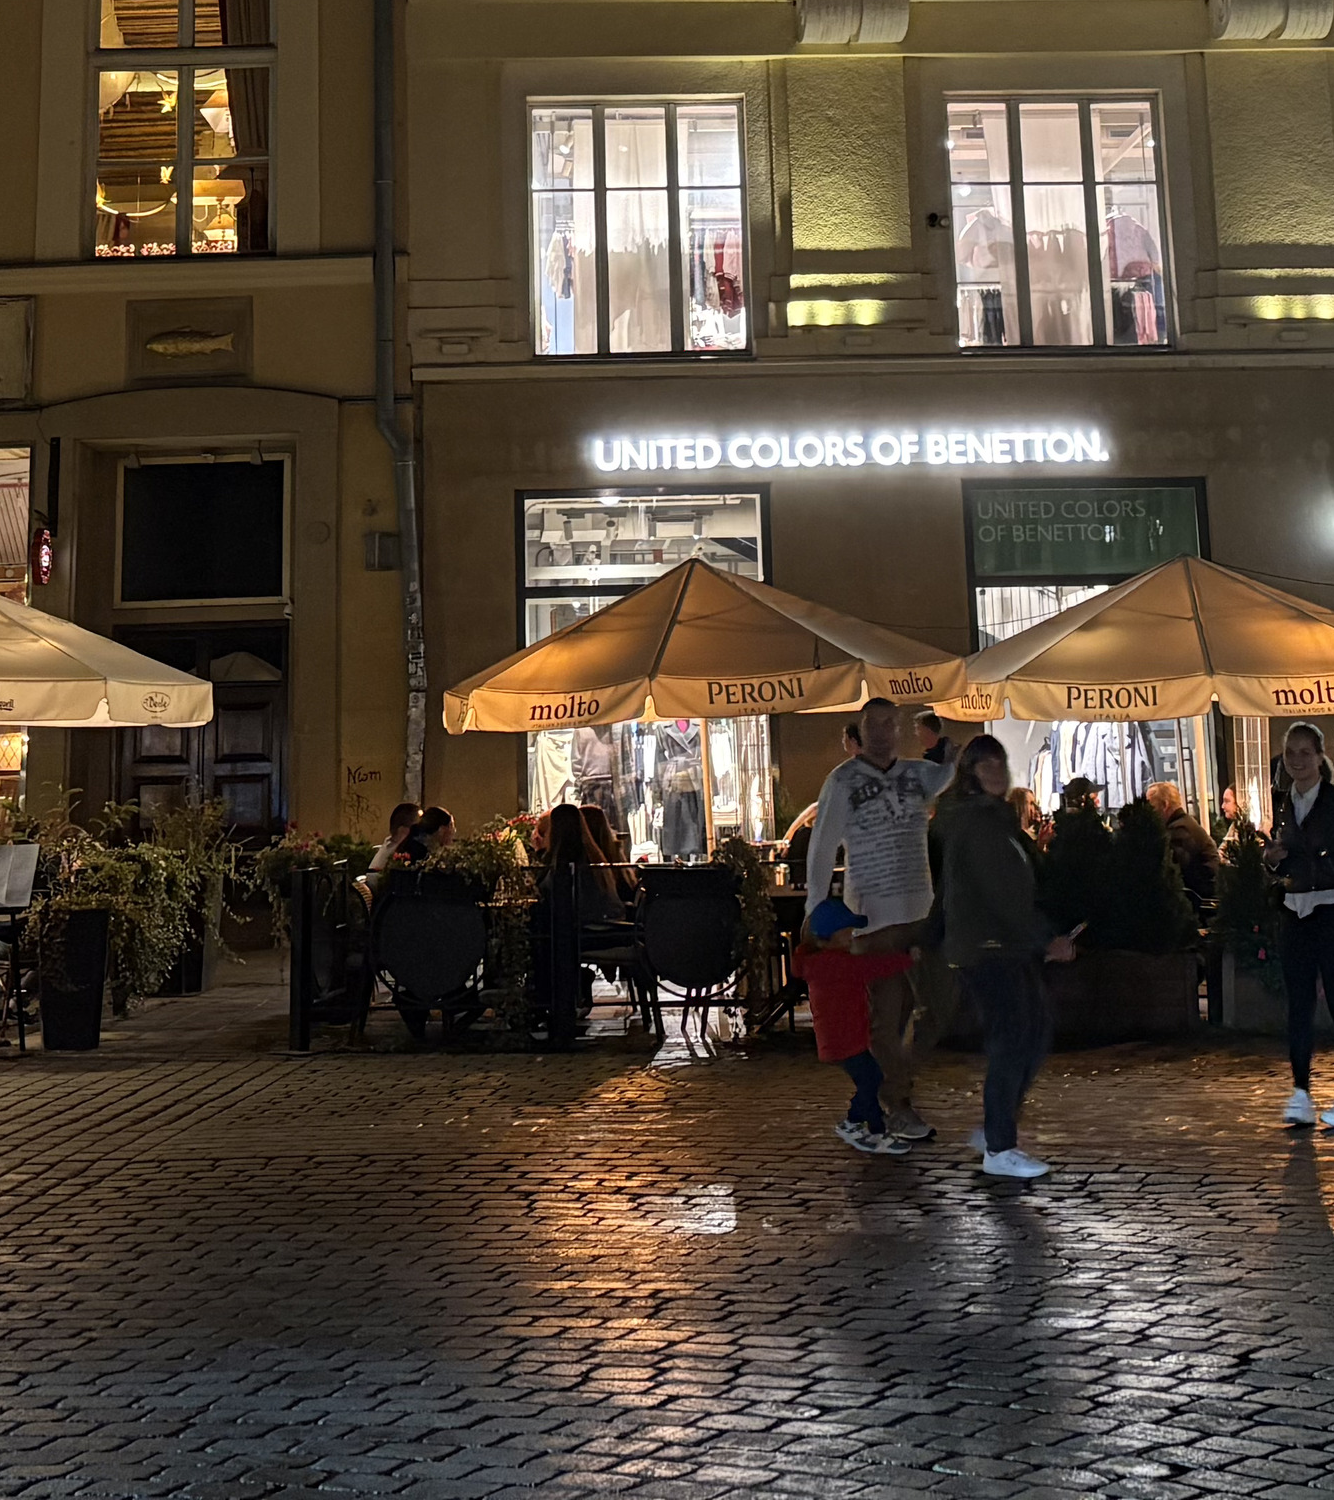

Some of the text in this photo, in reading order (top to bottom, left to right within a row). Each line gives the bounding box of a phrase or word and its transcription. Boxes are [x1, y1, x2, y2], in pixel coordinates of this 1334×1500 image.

[594, 430, 1110, 471] UNITED COLORS OF BENETTON.
[977, 500, 1146, 519] UNITED COLORS
[979, 525, 1007, 542] OF
[707, 678, 804, 705] PERONI
[889, 671, 933, 695] molto
[529, 695, 600, 720] molto
[1066, 685, 1157, 709] PERONI
[738, 706, 777, 714] ITALIA
